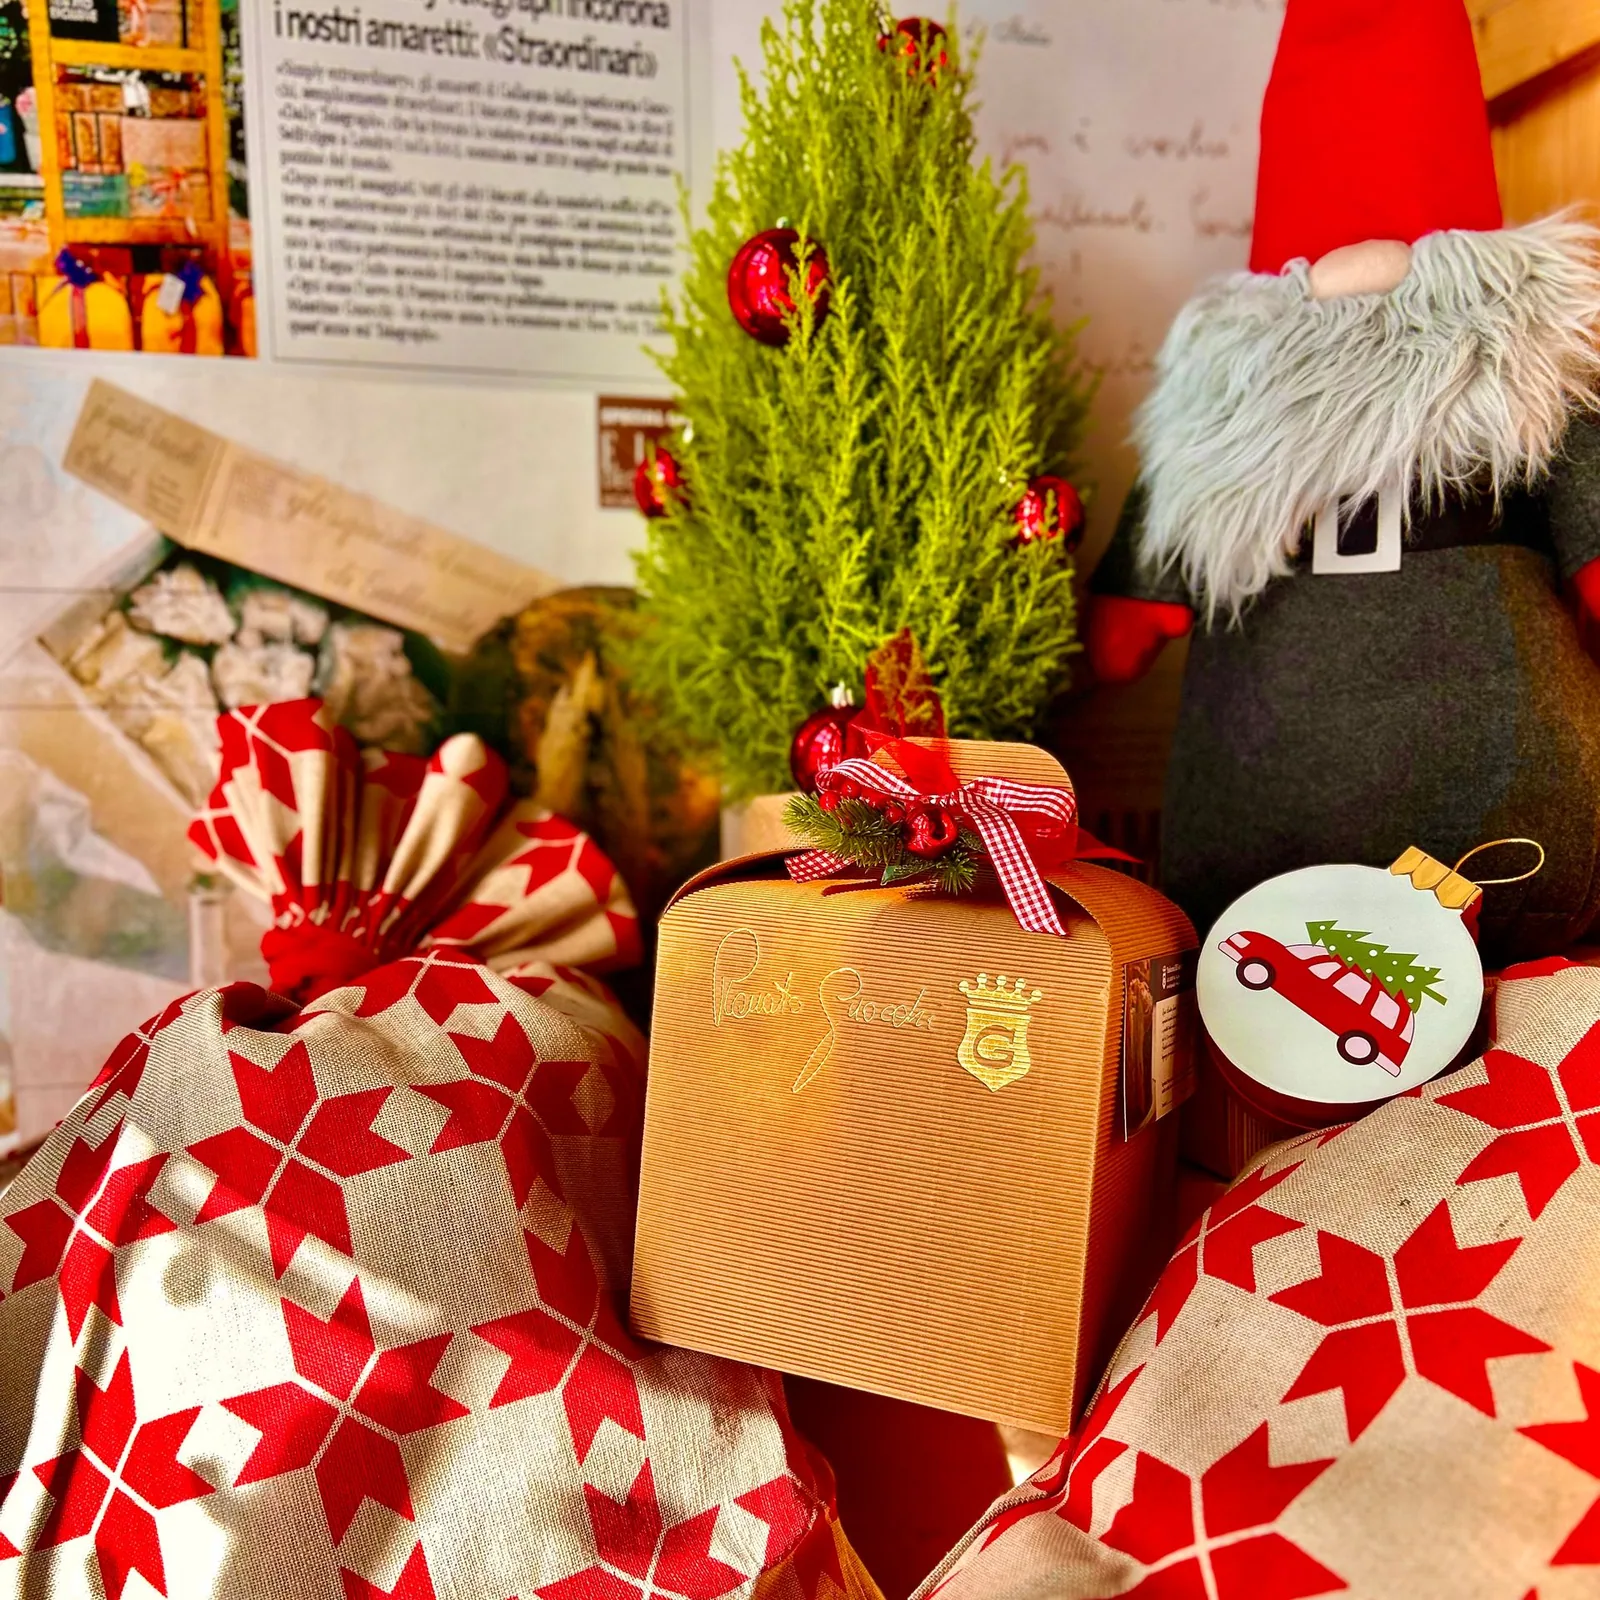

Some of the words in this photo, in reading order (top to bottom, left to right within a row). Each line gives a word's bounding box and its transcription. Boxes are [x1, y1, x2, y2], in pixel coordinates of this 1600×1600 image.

[275, 0, 283, 37] i
[287, 6, 361, 46] nostri
[366, 18, 479, 57] amaretti:
[972, 1024, 1016, 1070] G
